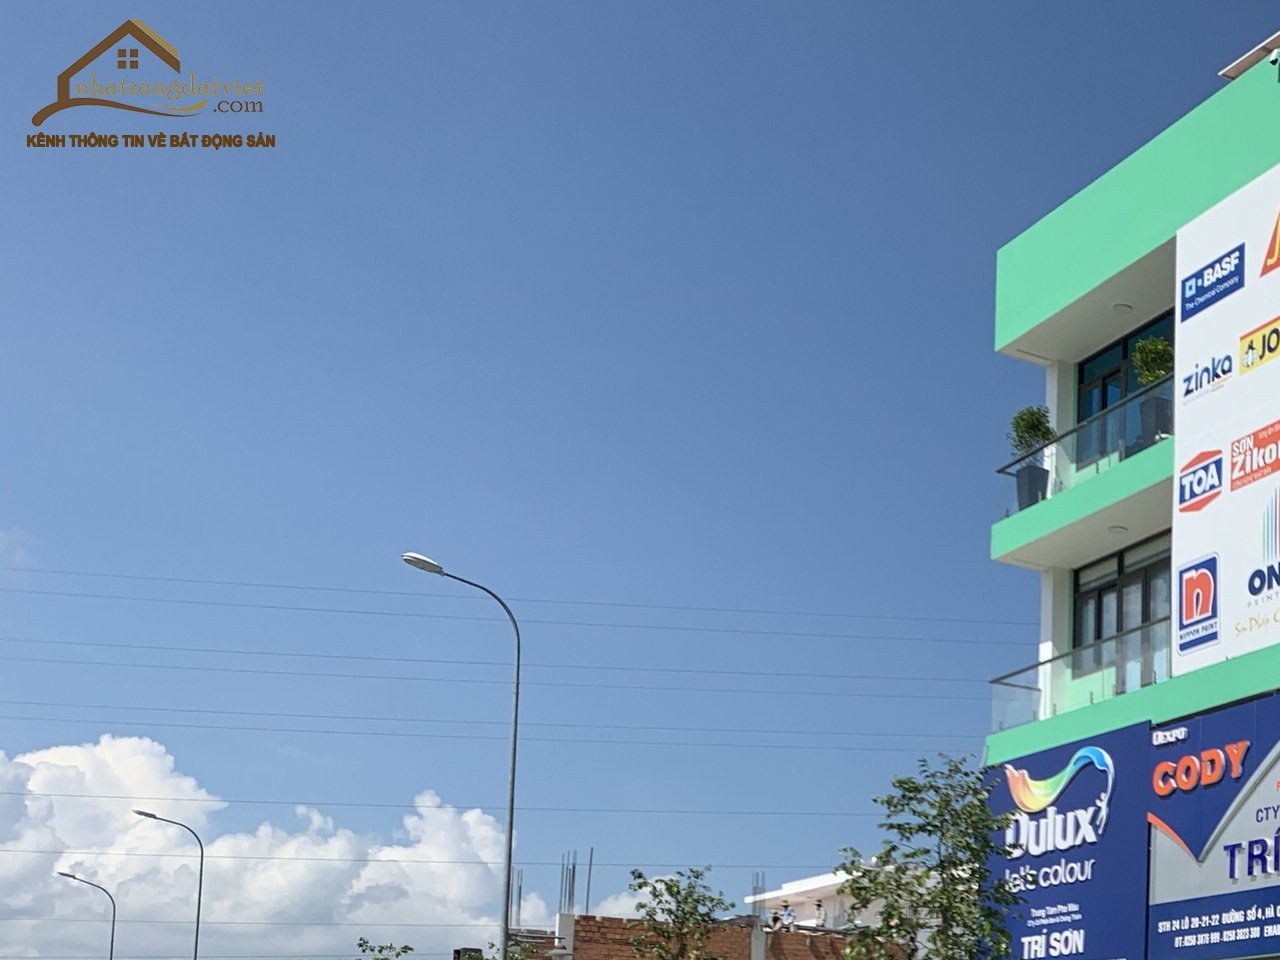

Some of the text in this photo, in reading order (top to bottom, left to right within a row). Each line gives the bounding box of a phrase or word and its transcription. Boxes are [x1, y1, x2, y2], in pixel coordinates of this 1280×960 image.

[1202, 250, 1241, 287] BASF
[1180, 462, 1221, 502] TOA
[1152, 740, 1251, 797] CODY
[1255, 804, 1280, 824] CTY
[1037, 858, 1097, 889] colour
[1020, 927, 1086, 960] TRÍ SƠN
